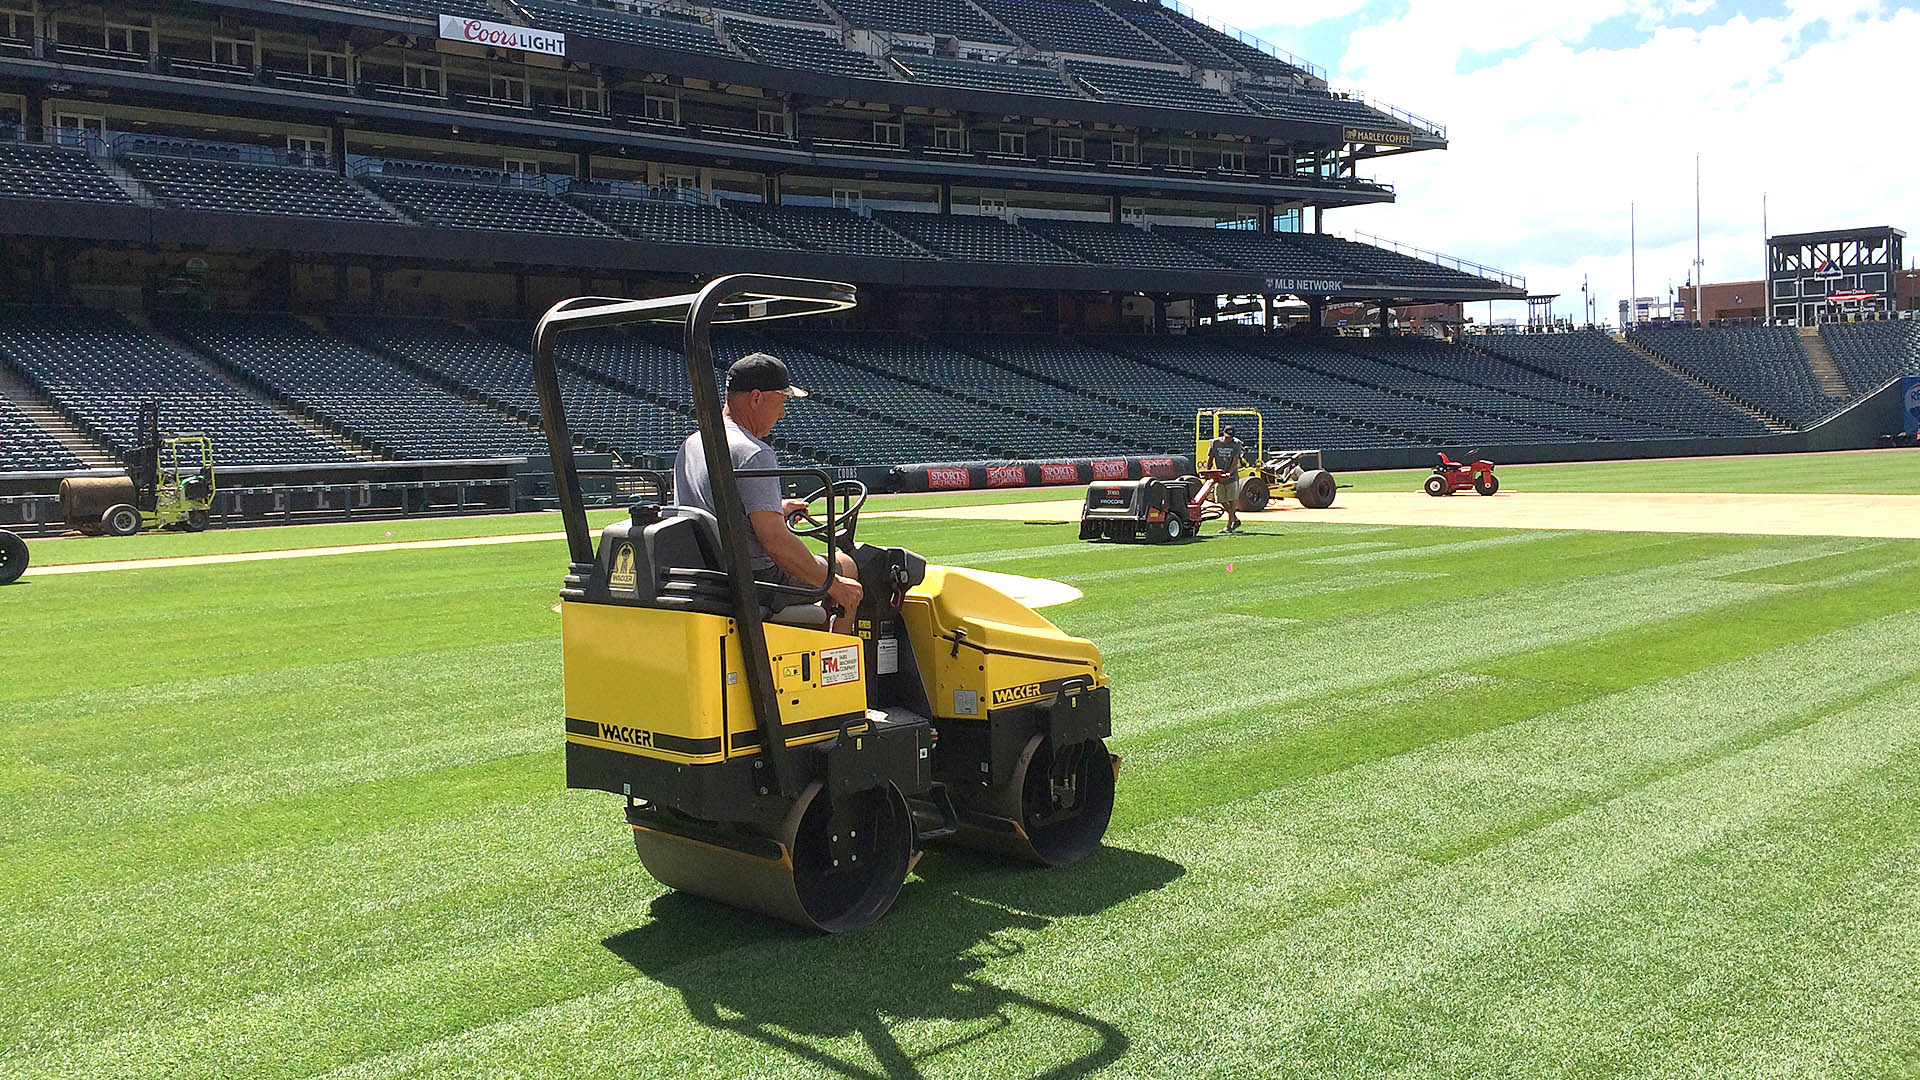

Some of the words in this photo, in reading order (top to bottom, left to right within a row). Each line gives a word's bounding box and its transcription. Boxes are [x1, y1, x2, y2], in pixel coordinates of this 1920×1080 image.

[463, 19, 518, 47] Coors
[520, 34, 565, 53] LIGHT
[1357, 132, 1384, 142] MARLEY
[1385, 134, 1410, 144] COFFEE
[1275, 279, 1294, 289] MLB
[1296, 280, 1341, 291] NETWORK
[837, 467, 858, 479] COORS
[990, 469, 1023, 479] SPORTS
[1043, 466, 1075, 475] SPORTS
[1094, 463, 1125, 473] SPORTS
[931, 471, 967, 480] SPORTS
[611, 574, 633, 582] WACKER
[994, 683, 1041, 703] WACKER
[600, 723, 652, 747] WACKER
